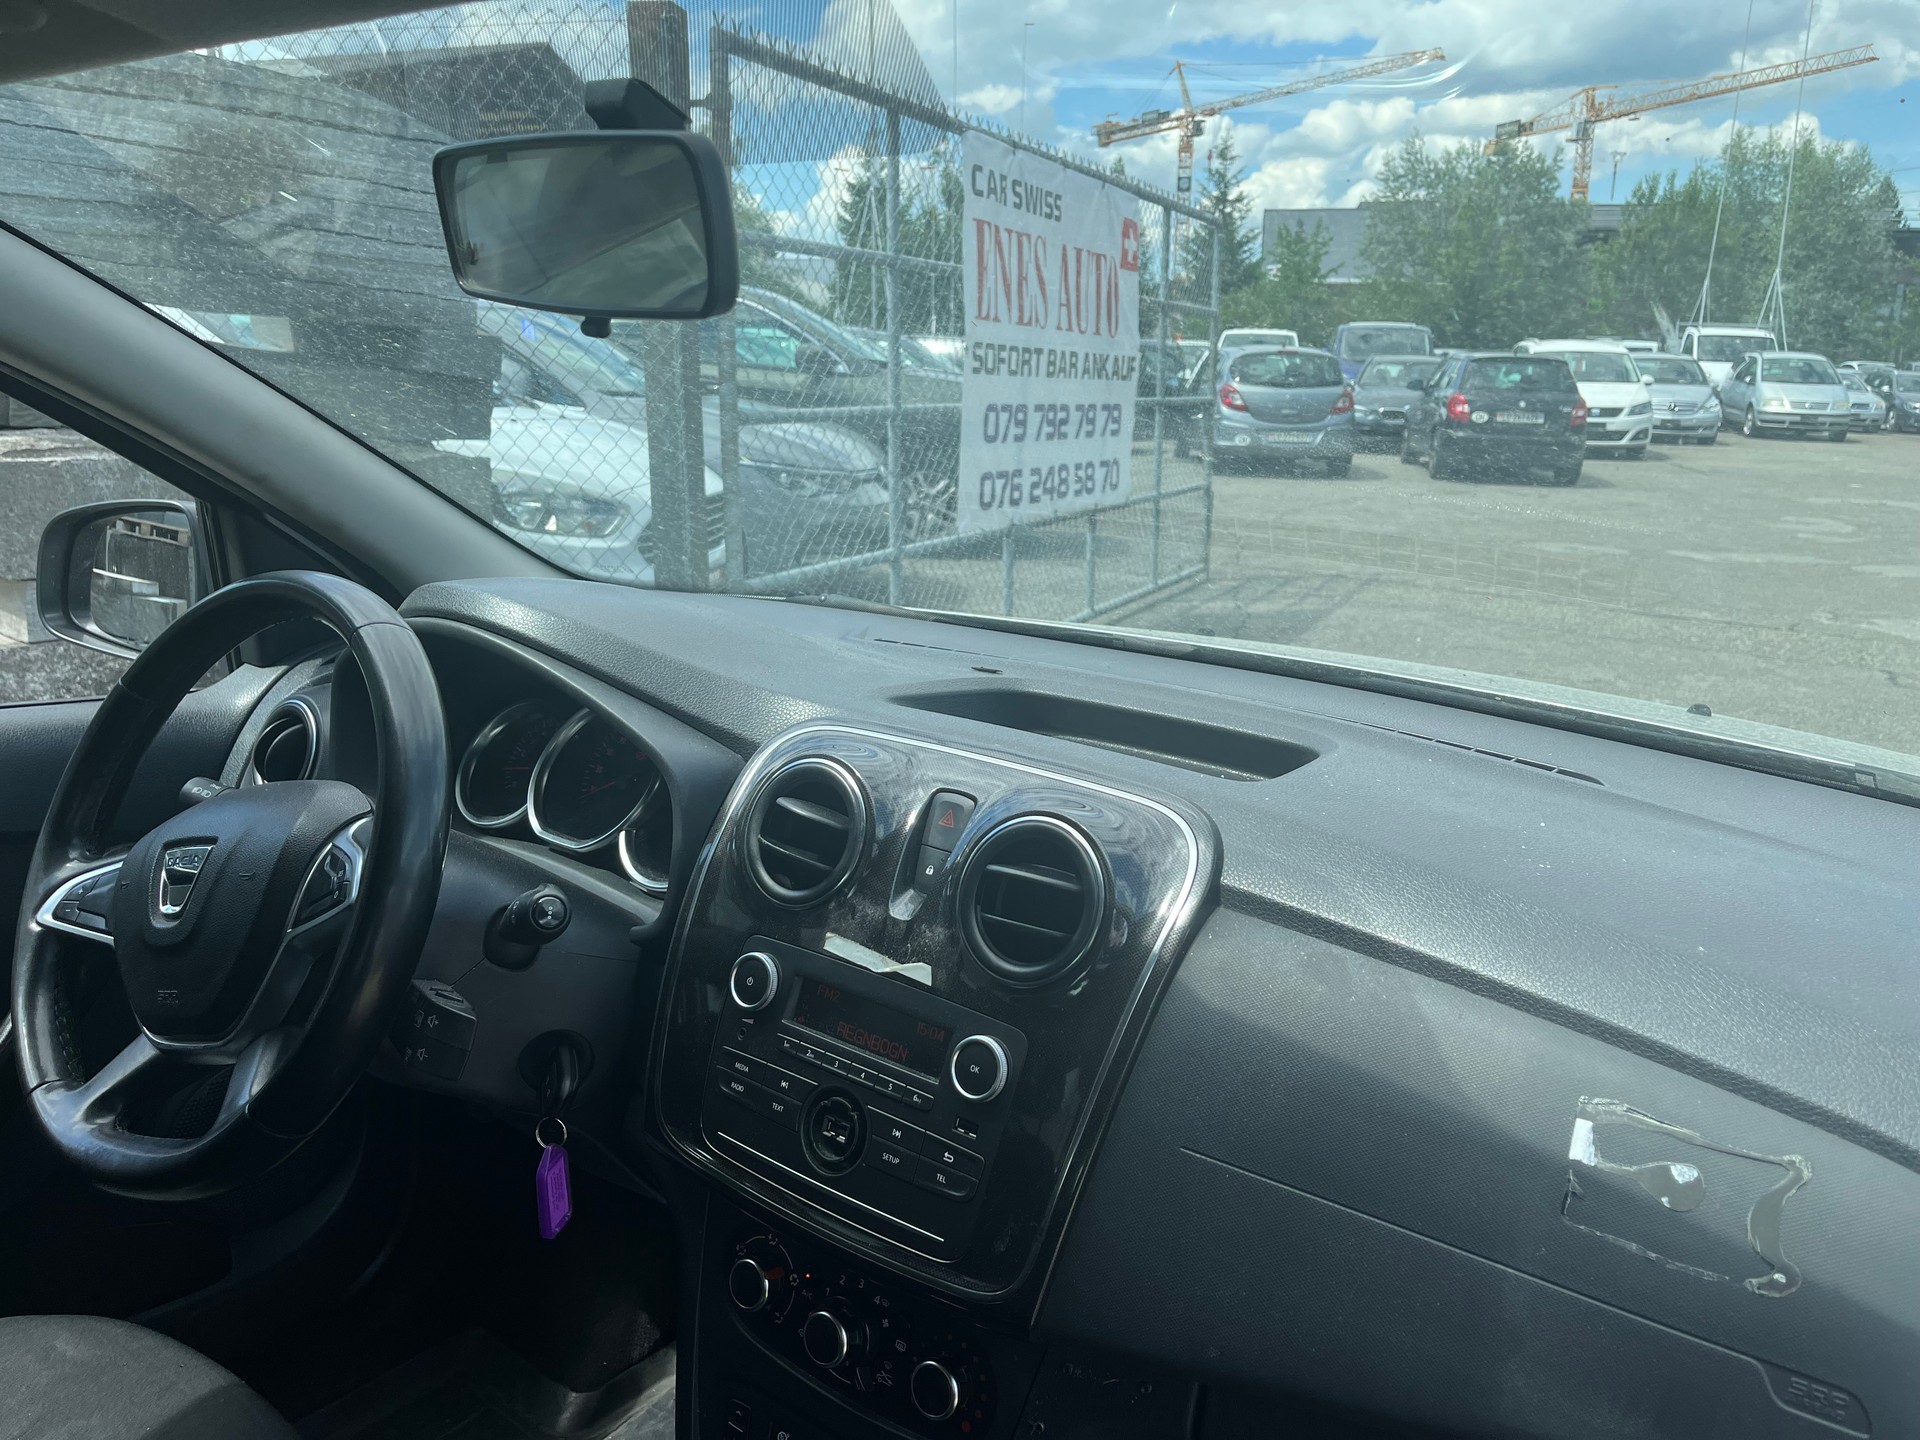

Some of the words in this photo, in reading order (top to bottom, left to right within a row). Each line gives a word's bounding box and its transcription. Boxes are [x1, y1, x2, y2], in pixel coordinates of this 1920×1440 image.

[971, 164, 1008, 204] CAR
[1012, 181, 1062, 222] SWISS
[973, 218, 1048, 329] ENES
[1056, 244, 1120, 338] AUTO
[972, 342, 1043, 378] SOFORT
[1047, 348, 1078, 380] BAR
[1081, 352, 1137, 382] ANKAUF
[984, 404, 1028, 444] 079
[1034, 404, 1068, 441] 792
[1074, 404, 1096, 439] 79
[1100, 403, 1122, 437] 79
[979, 470, 1023, 511] 076
[1029, 464, 1070, 504] 248
[1074, 460, 1095, 498] 58
[1100, 458, 1120, 494] 70
[837, 1021, 909, 1061] REGNBOGN
[735, 1061, 750, 1074] MEDIA
[833, 1060, 839, 1069] 3
[969, 1064, 980, 1075] OK
[860, 1071, 866, 1080] 4
[730, 1081, 745, 1093] RADIO
[887, 1082, 893, 1091] 5
[771, 1102, 784, 1113] TEXT
[882, 1152, 900, 1165] SETUP
[936, 1173, 946, 1184] TEL
[839, 1275, 846, 1285] 2
[858, 1278, 865, 1289] 3
[873, 1295, 881, 1305] 4
